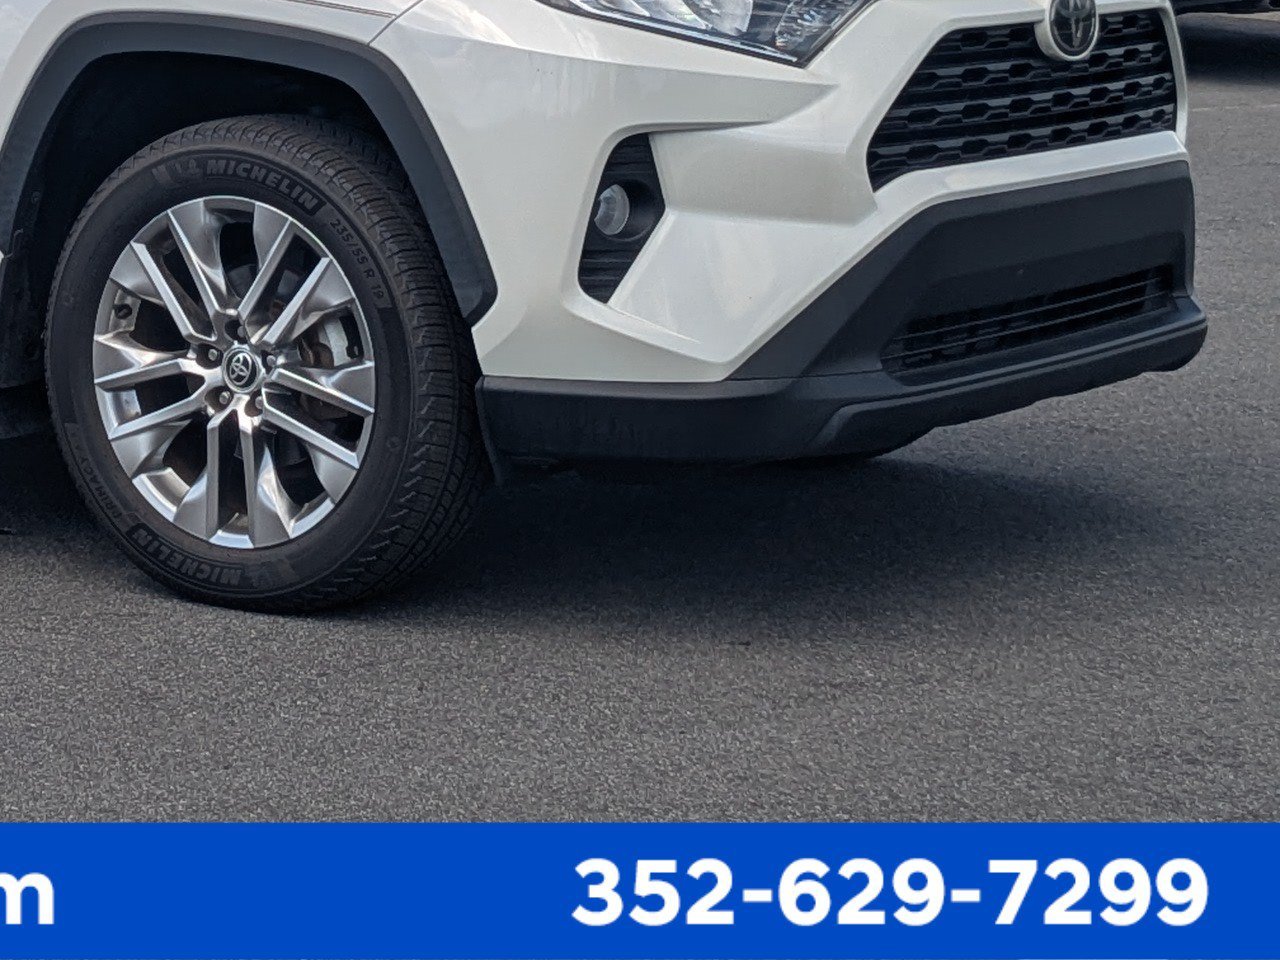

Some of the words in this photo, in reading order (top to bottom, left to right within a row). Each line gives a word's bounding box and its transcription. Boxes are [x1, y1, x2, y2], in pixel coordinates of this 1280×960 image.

[206, 159, 321, 212] MICHELIN
[330, 219, 368, 264] 235/55
[131, 527, 242, 586] MICHELIN
